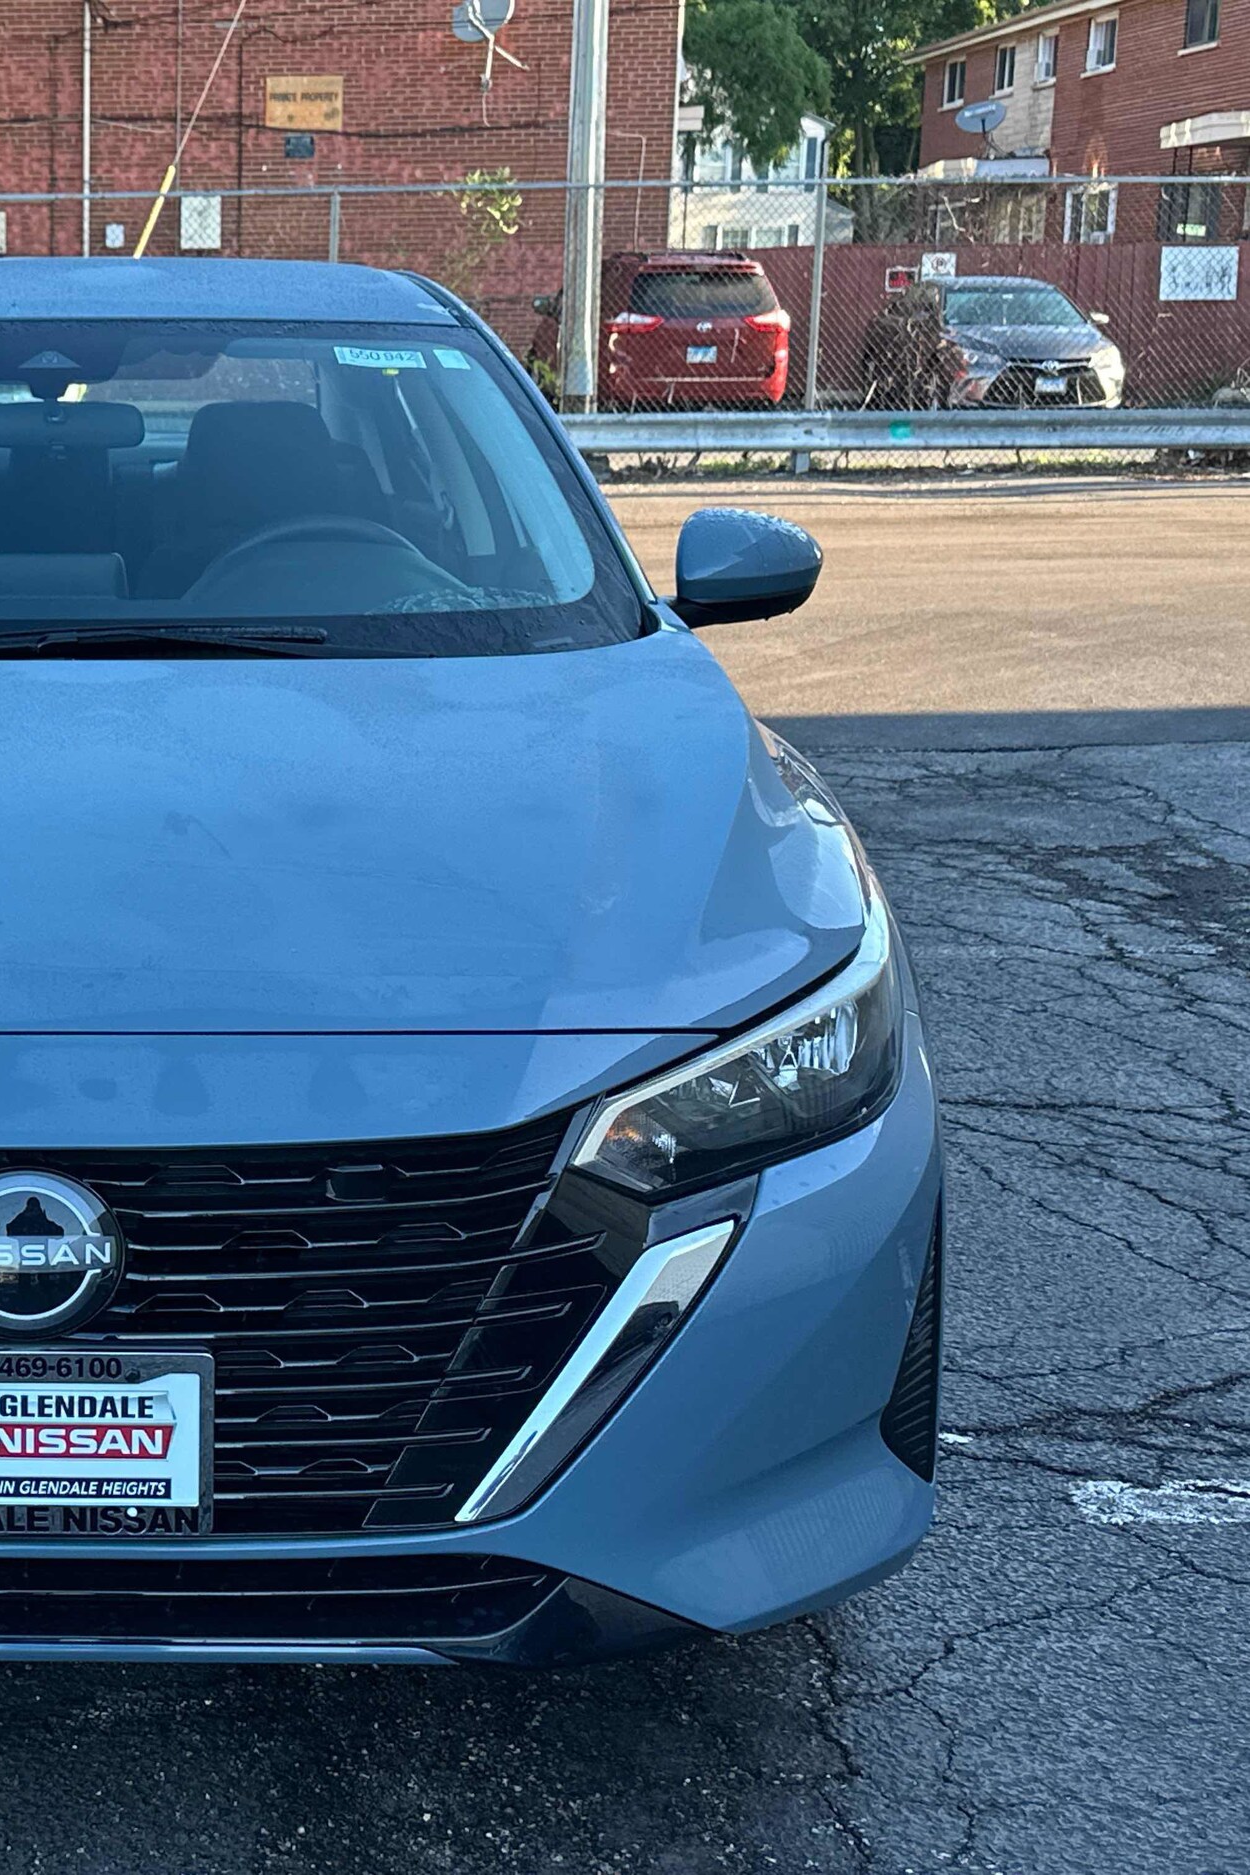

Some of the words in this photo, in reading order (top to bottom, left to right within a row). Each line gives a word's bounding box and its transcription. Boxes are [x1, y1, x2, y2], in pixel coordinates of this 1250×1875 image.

[0, 1394, 153, 1418] GLENDALE
[19, 1480, 99, 1495] GLENDALE
[100, 1481, 166, 1496] HEIGHTS
[62, 1505, 199, 1533] NISSAN
